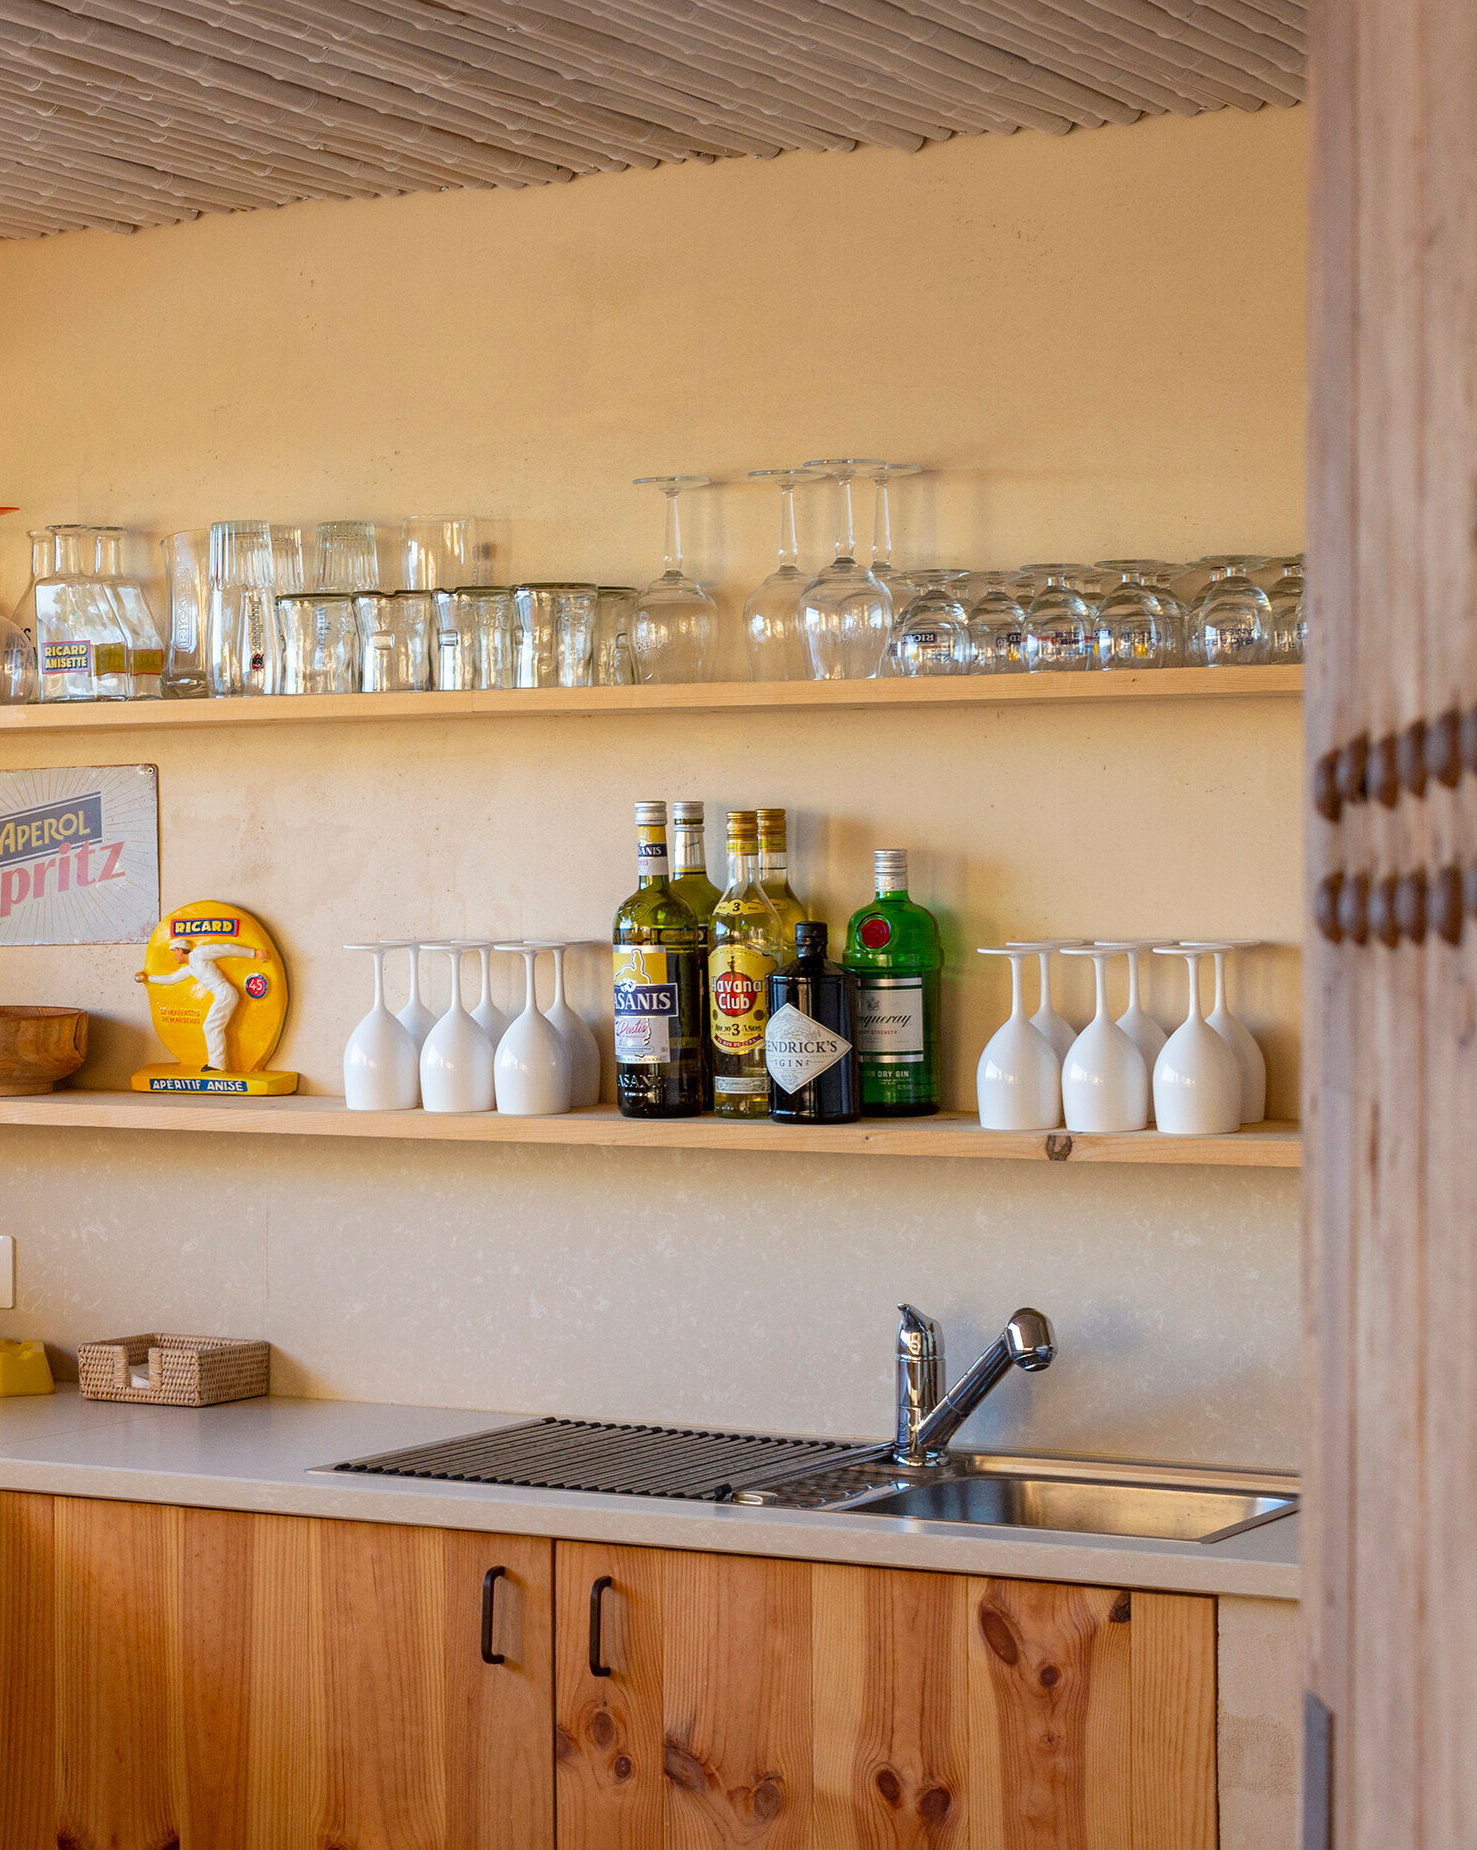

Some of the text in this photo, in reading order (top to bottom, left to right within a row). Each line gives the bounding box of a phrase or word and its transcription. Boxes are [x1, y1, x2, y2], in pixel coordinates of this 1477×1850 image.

[44, 644, 86, 657] RICARD
[45, 656, 87, 669] ANISETTE
[732, 902, 741, 912] 3
[175, 920, 233, 934] RICARD
[248, 979, 263, 992] 45
[711, 976, 763, 992] Havana
[614, 991, 672, 1010] ASANIS
[718, 993, 751, 1009] Club
[731, 1023, 741, 1036] 3
[766, 1040, 838, 1053] ENDRICK'S
[779, 1059, 803, 1067] GIN
[877, 1070, 893, 1078] DRY
[895, 1070, 910, 1078] GIN
[152, 1078, 245, 1092] APÉRITIF ANISÉ
